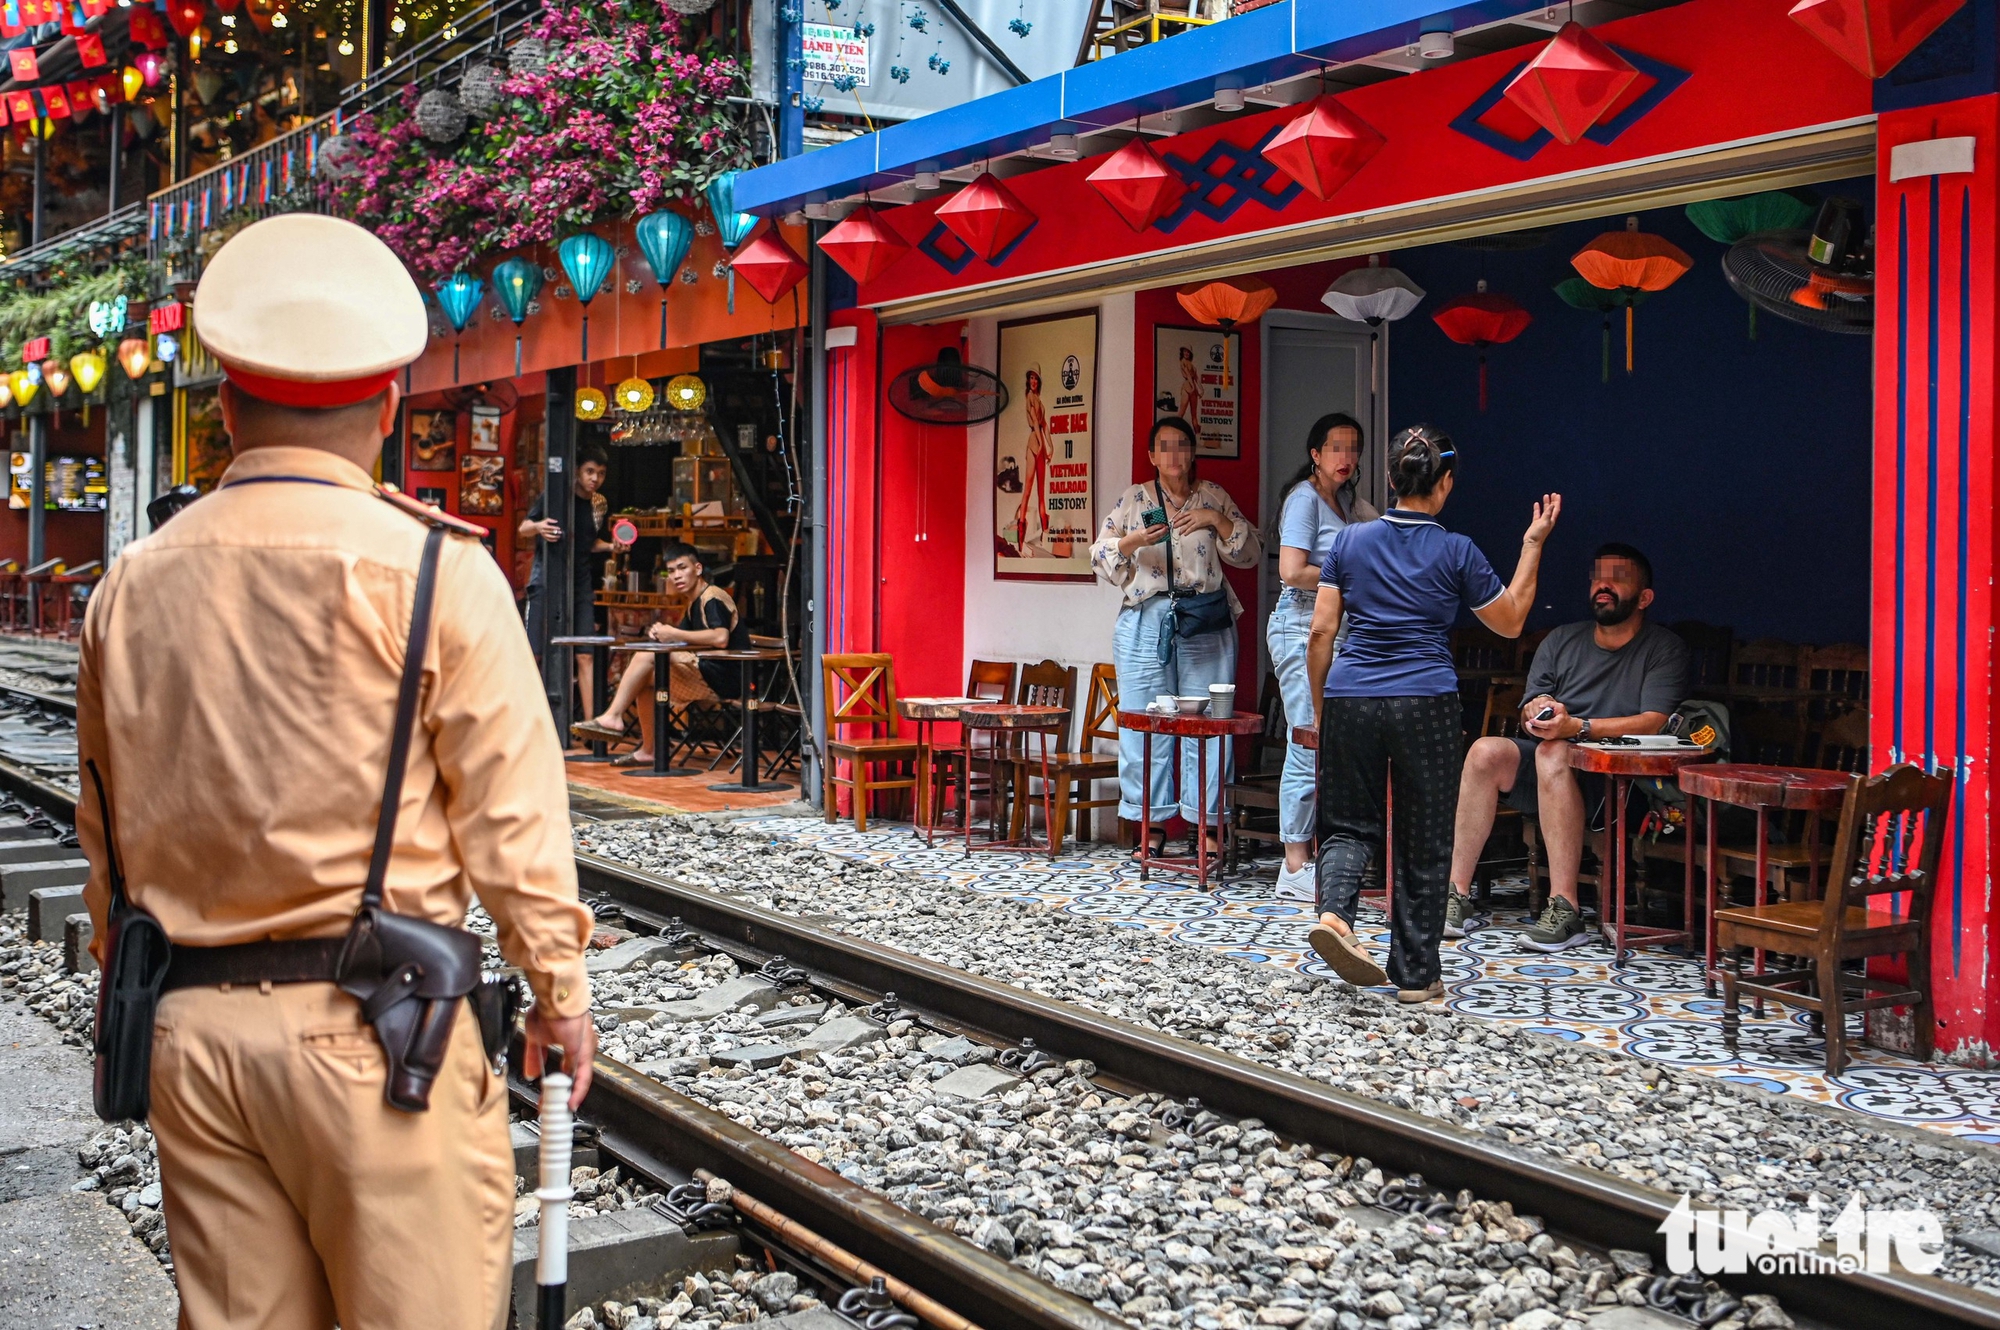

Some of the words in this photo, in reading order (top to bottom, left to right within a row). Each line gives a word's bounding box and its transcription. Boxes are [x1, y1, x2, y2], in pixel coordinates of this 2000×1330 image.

[836, 42, 864, 56] VIÊN
[804, 61, 866, 75] 986.307520
[1219, 375, 1234, 386] BK
[1214, 388, 1221, 398] TO
[1201, 400, 1234, 409] VIETNAM
[1200, 408, 1234, 417] RAILROAD
[1050, 414, 1069, 434] COME
[1070, 412, 1088, 433] BACK
[1200, 416, 1233, 425] HISTORY
[1065, 440, 1073, 459] TO
[1049, 463, 1088, 478] VIETNAM
[1049, 480, 1088, 494] RAILROAD
[1048, 498, 1088, 510] HISTORY
[656, 691, 669, 702] 05
